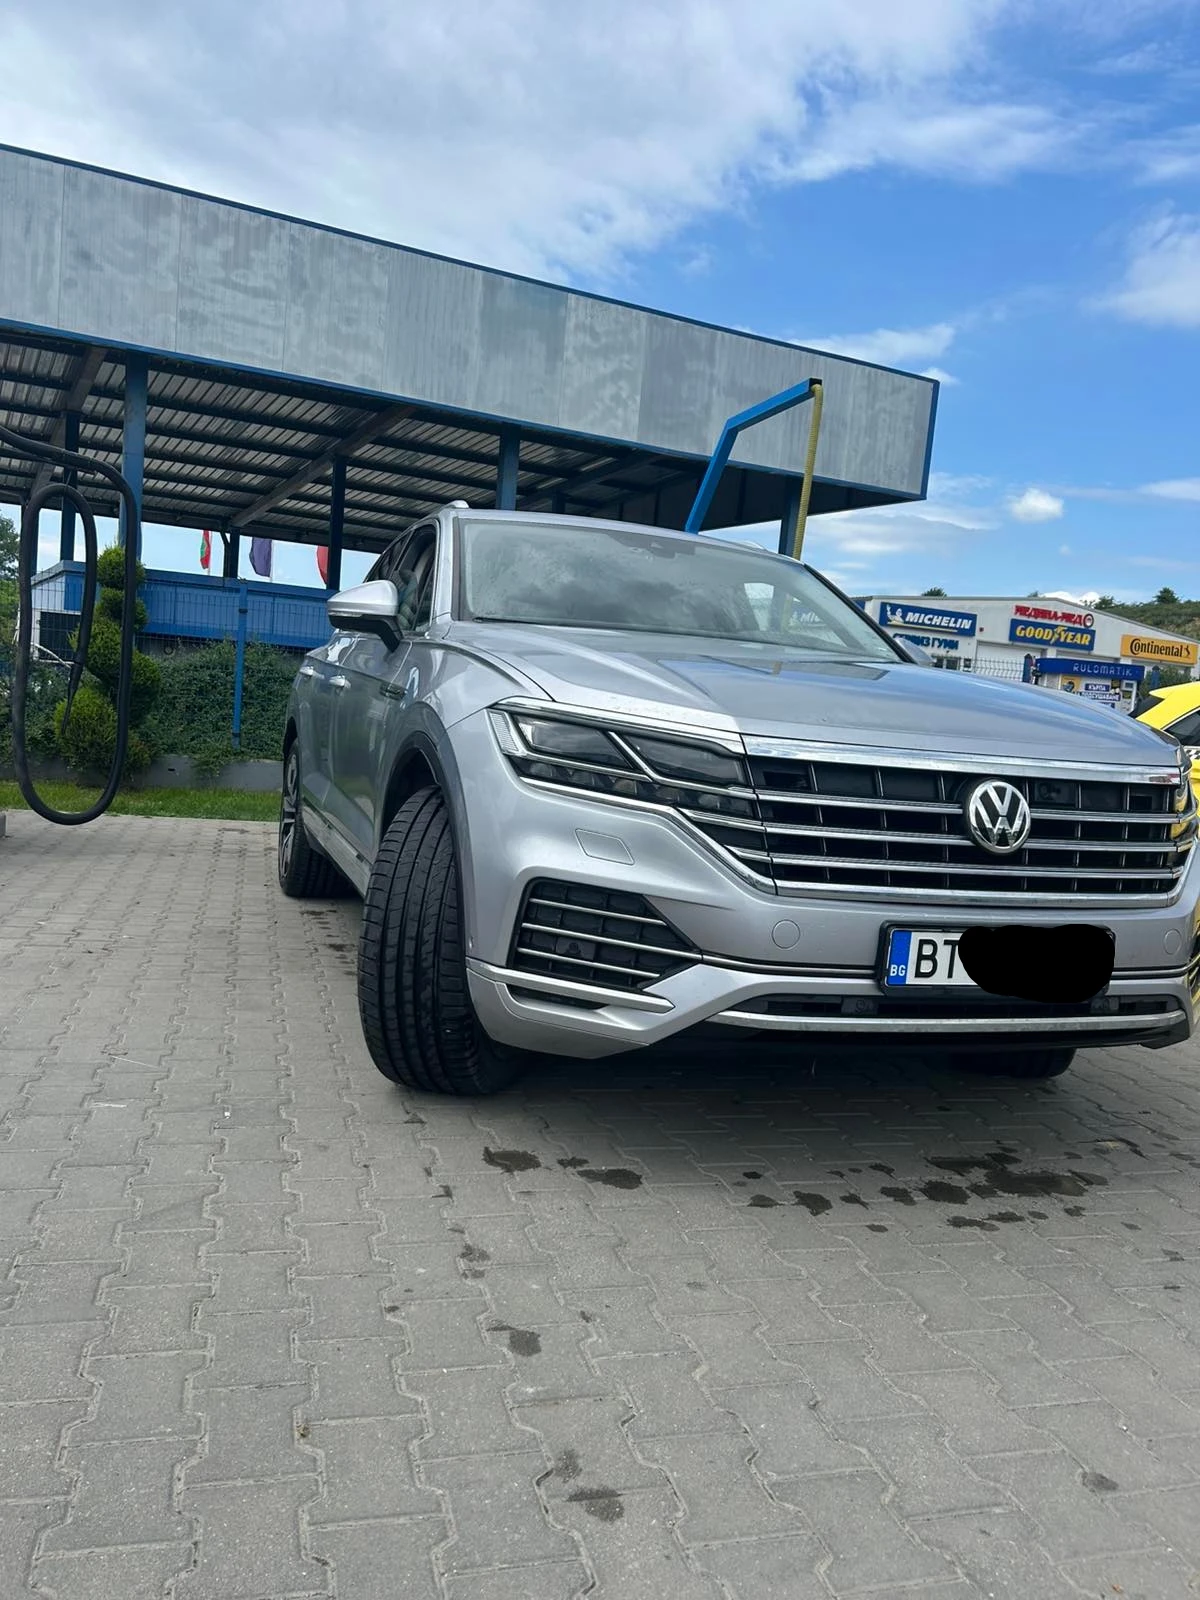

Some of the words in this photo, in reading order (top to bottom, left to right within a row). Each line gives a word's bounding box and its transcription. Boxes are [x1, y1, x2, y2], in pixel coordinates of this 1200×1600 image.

[905, 612, 973, 630] MICHELIN
[1015, 625, 1091, 646] GOODYEAR
[1129, 638, 1183, 657] Continental
[1072, 662, 1133, 677] RULOMATIK
[890, 964, 907, 977] BG
